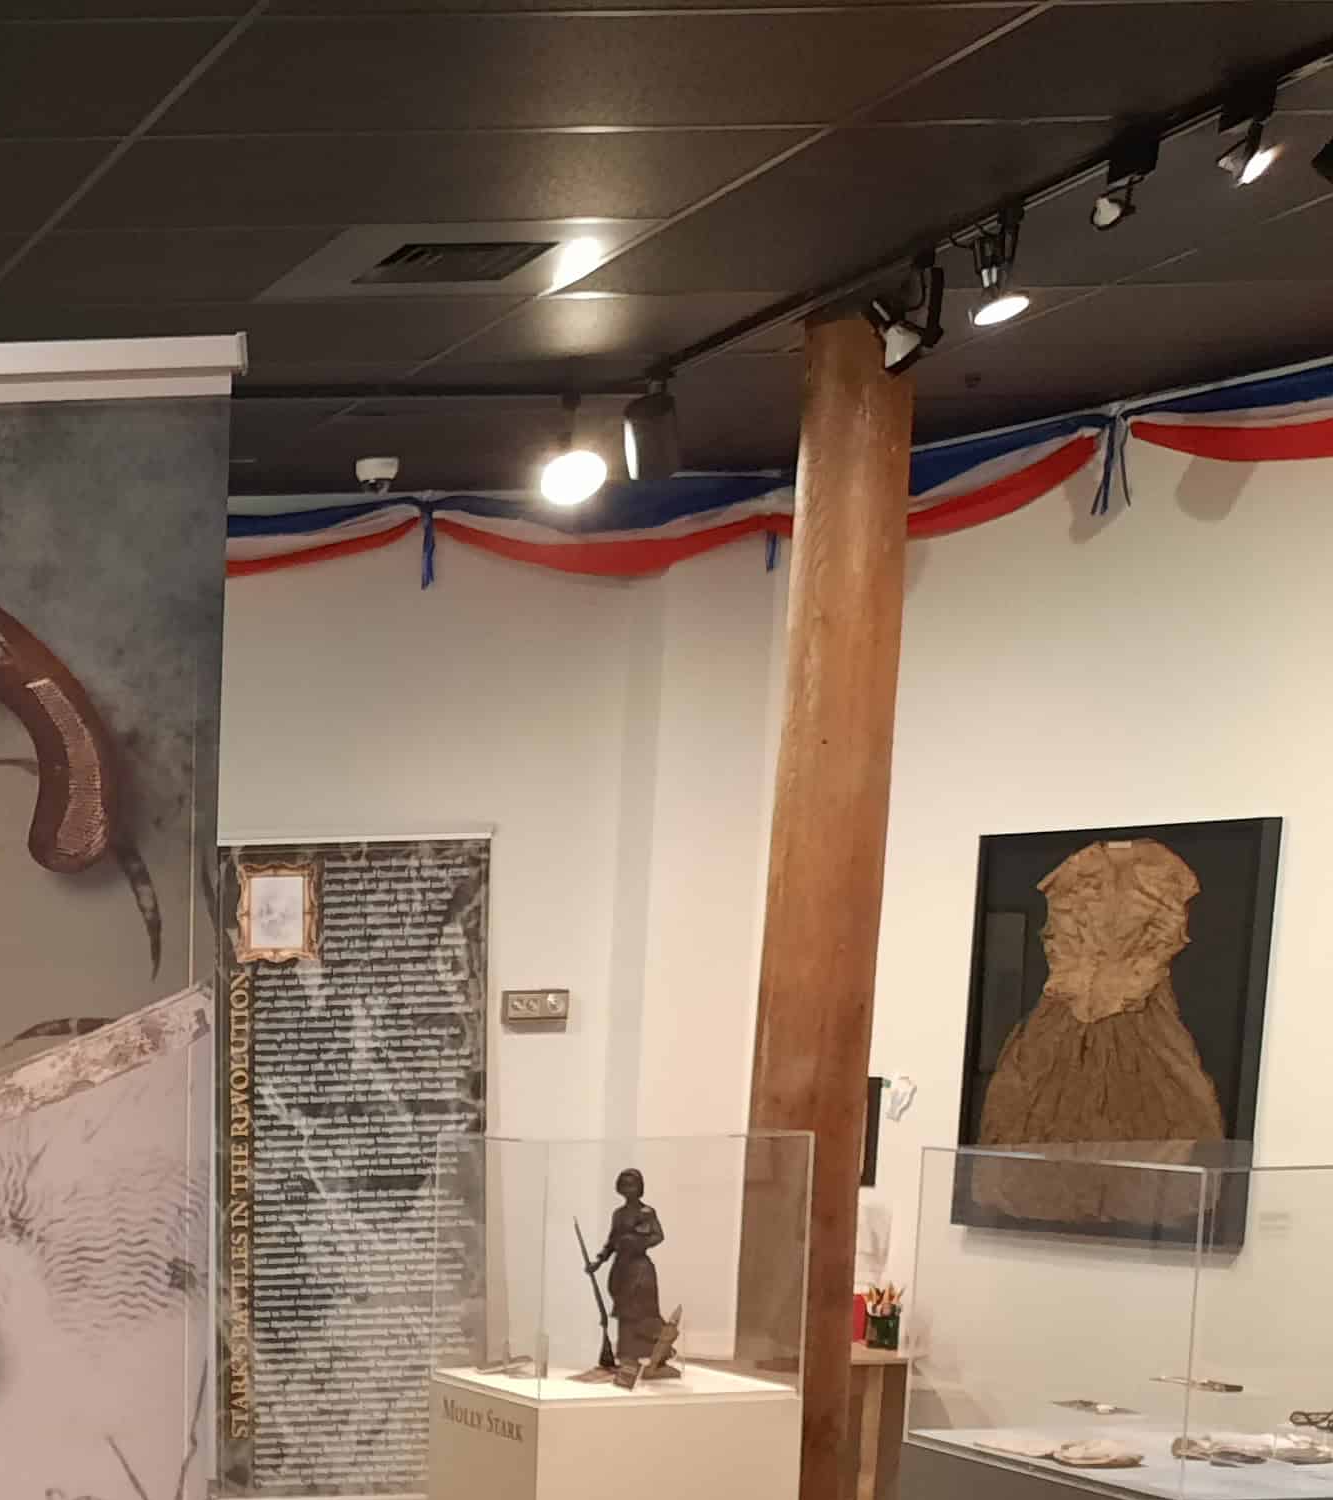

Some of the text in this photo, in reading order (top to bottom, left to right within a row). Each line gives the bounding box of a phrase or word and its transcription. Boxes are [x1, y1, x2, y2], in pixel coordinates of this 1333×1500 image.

[229, 972, 250, 1137] REVOLUTION
[229, 1143, 249, 1196] THE
[229, 1200, 249, 1227] IN
[229, 1233, 249, 1338] BATTLES
